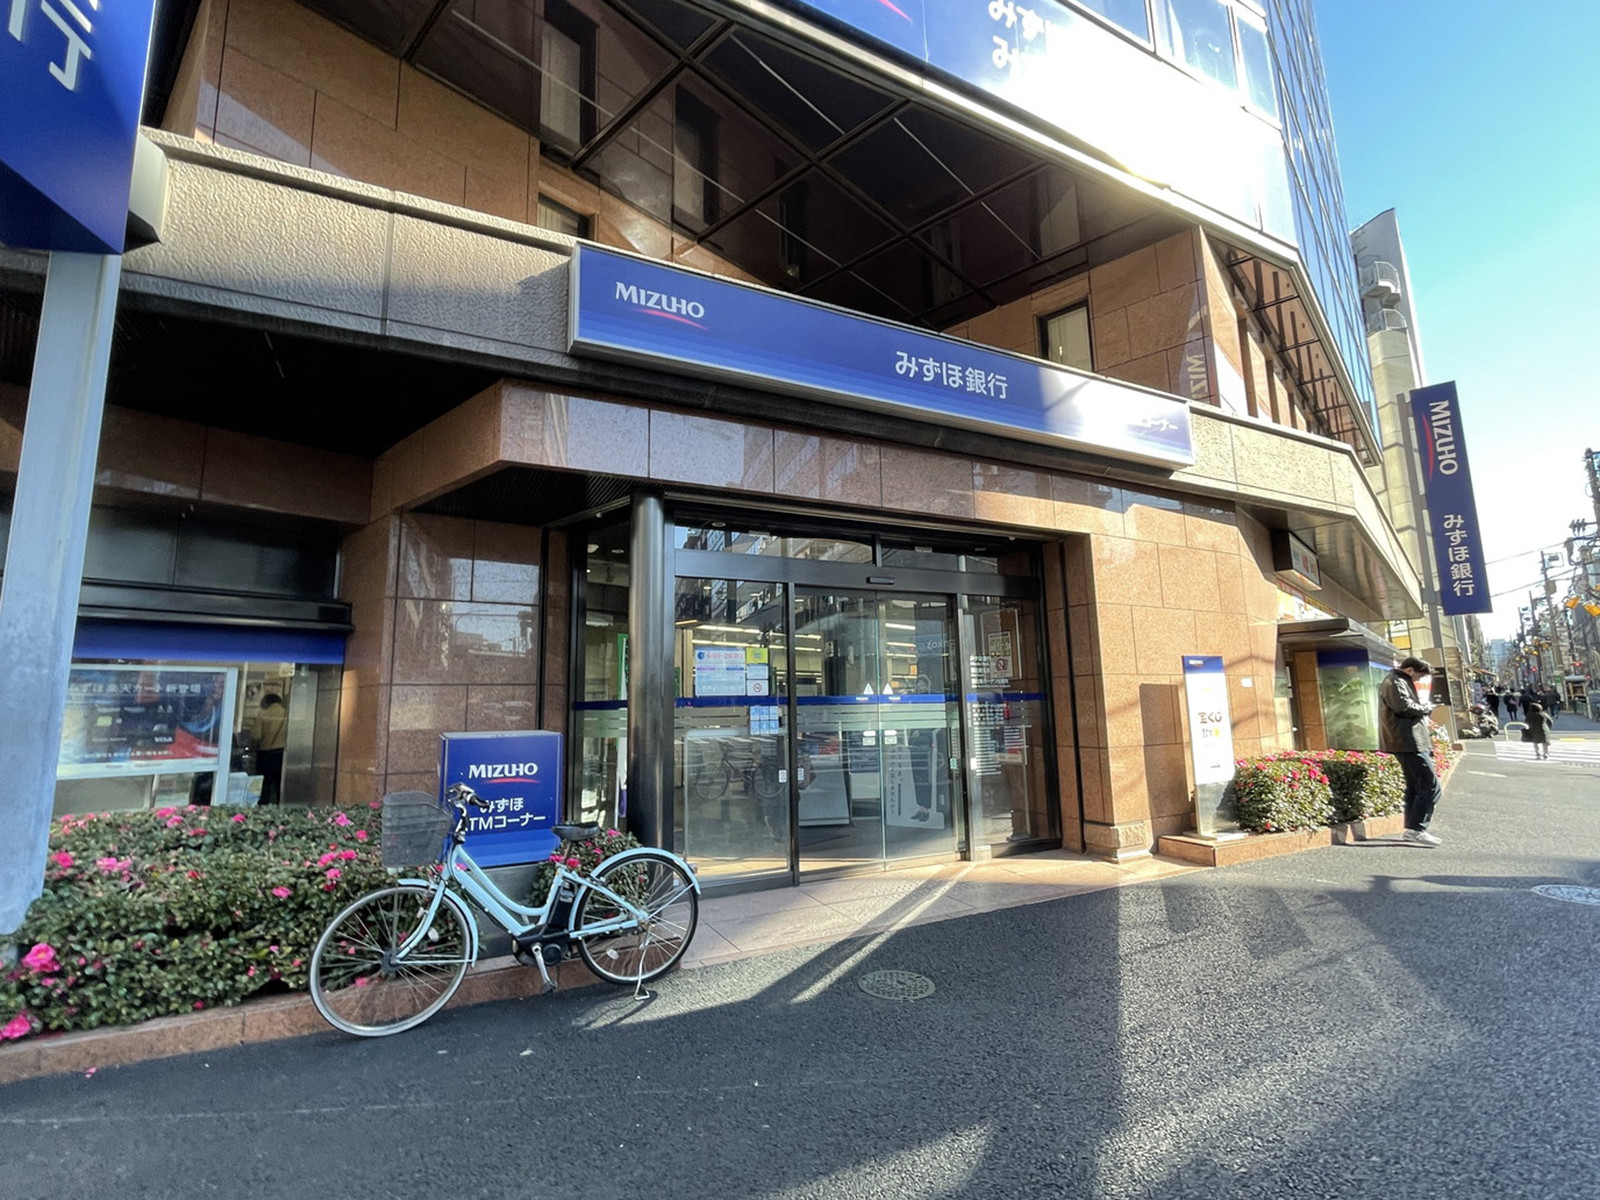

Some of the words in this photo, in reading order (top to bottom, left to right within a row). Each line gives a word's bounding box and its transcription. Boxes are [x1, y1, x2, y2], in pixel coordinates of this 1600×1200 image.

[615, 281, 705, 319] MIZUHO
[895, 350, 1008, 400] みずほ銀行
[1429, 399, 1458, 475] MIZUHO
[1443, 513, 1474, 597] みずほ銀行
[468, 763, 538, 779] MIZUHO
